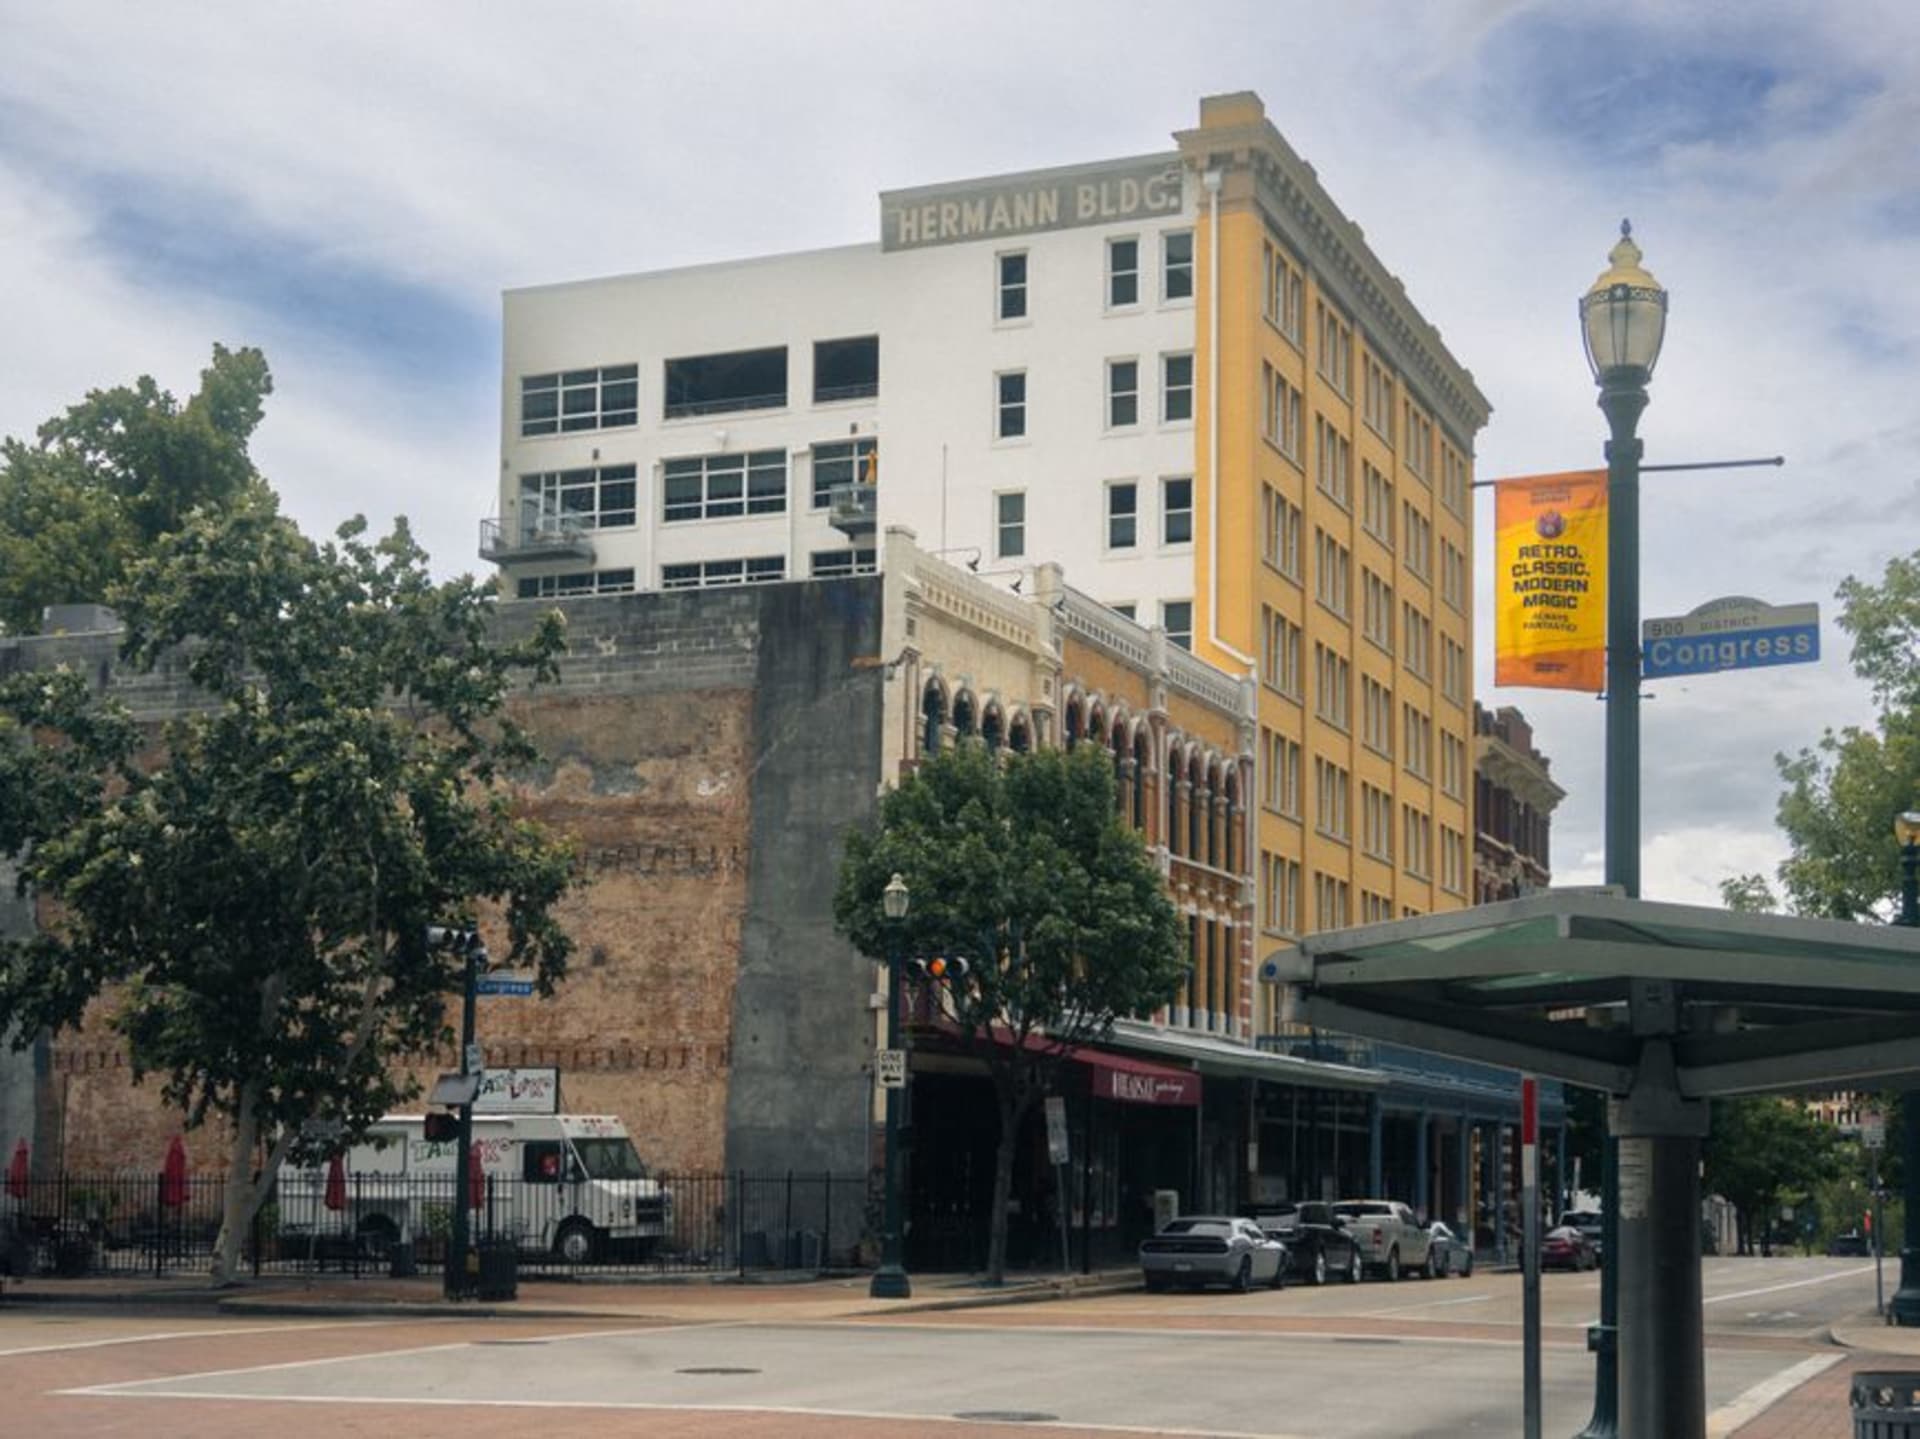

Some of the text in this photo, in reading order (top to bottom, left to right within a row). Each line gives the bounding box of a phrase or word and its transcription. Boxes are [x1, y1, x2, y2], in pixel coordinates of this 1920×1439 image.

[900, 188, 1057, 242] HERMANN
[1518, 544, 1582, 560] RETRO.
[1511, 561, 1590, 577] CLASSIC.
[1513, 577, 1589, 593] MODERN
[1522, 595, 1578, 609] MAGIC
[1701, 615, 1759, 632] DISTRICT
[1651, 632, 1811, 667] Congress
